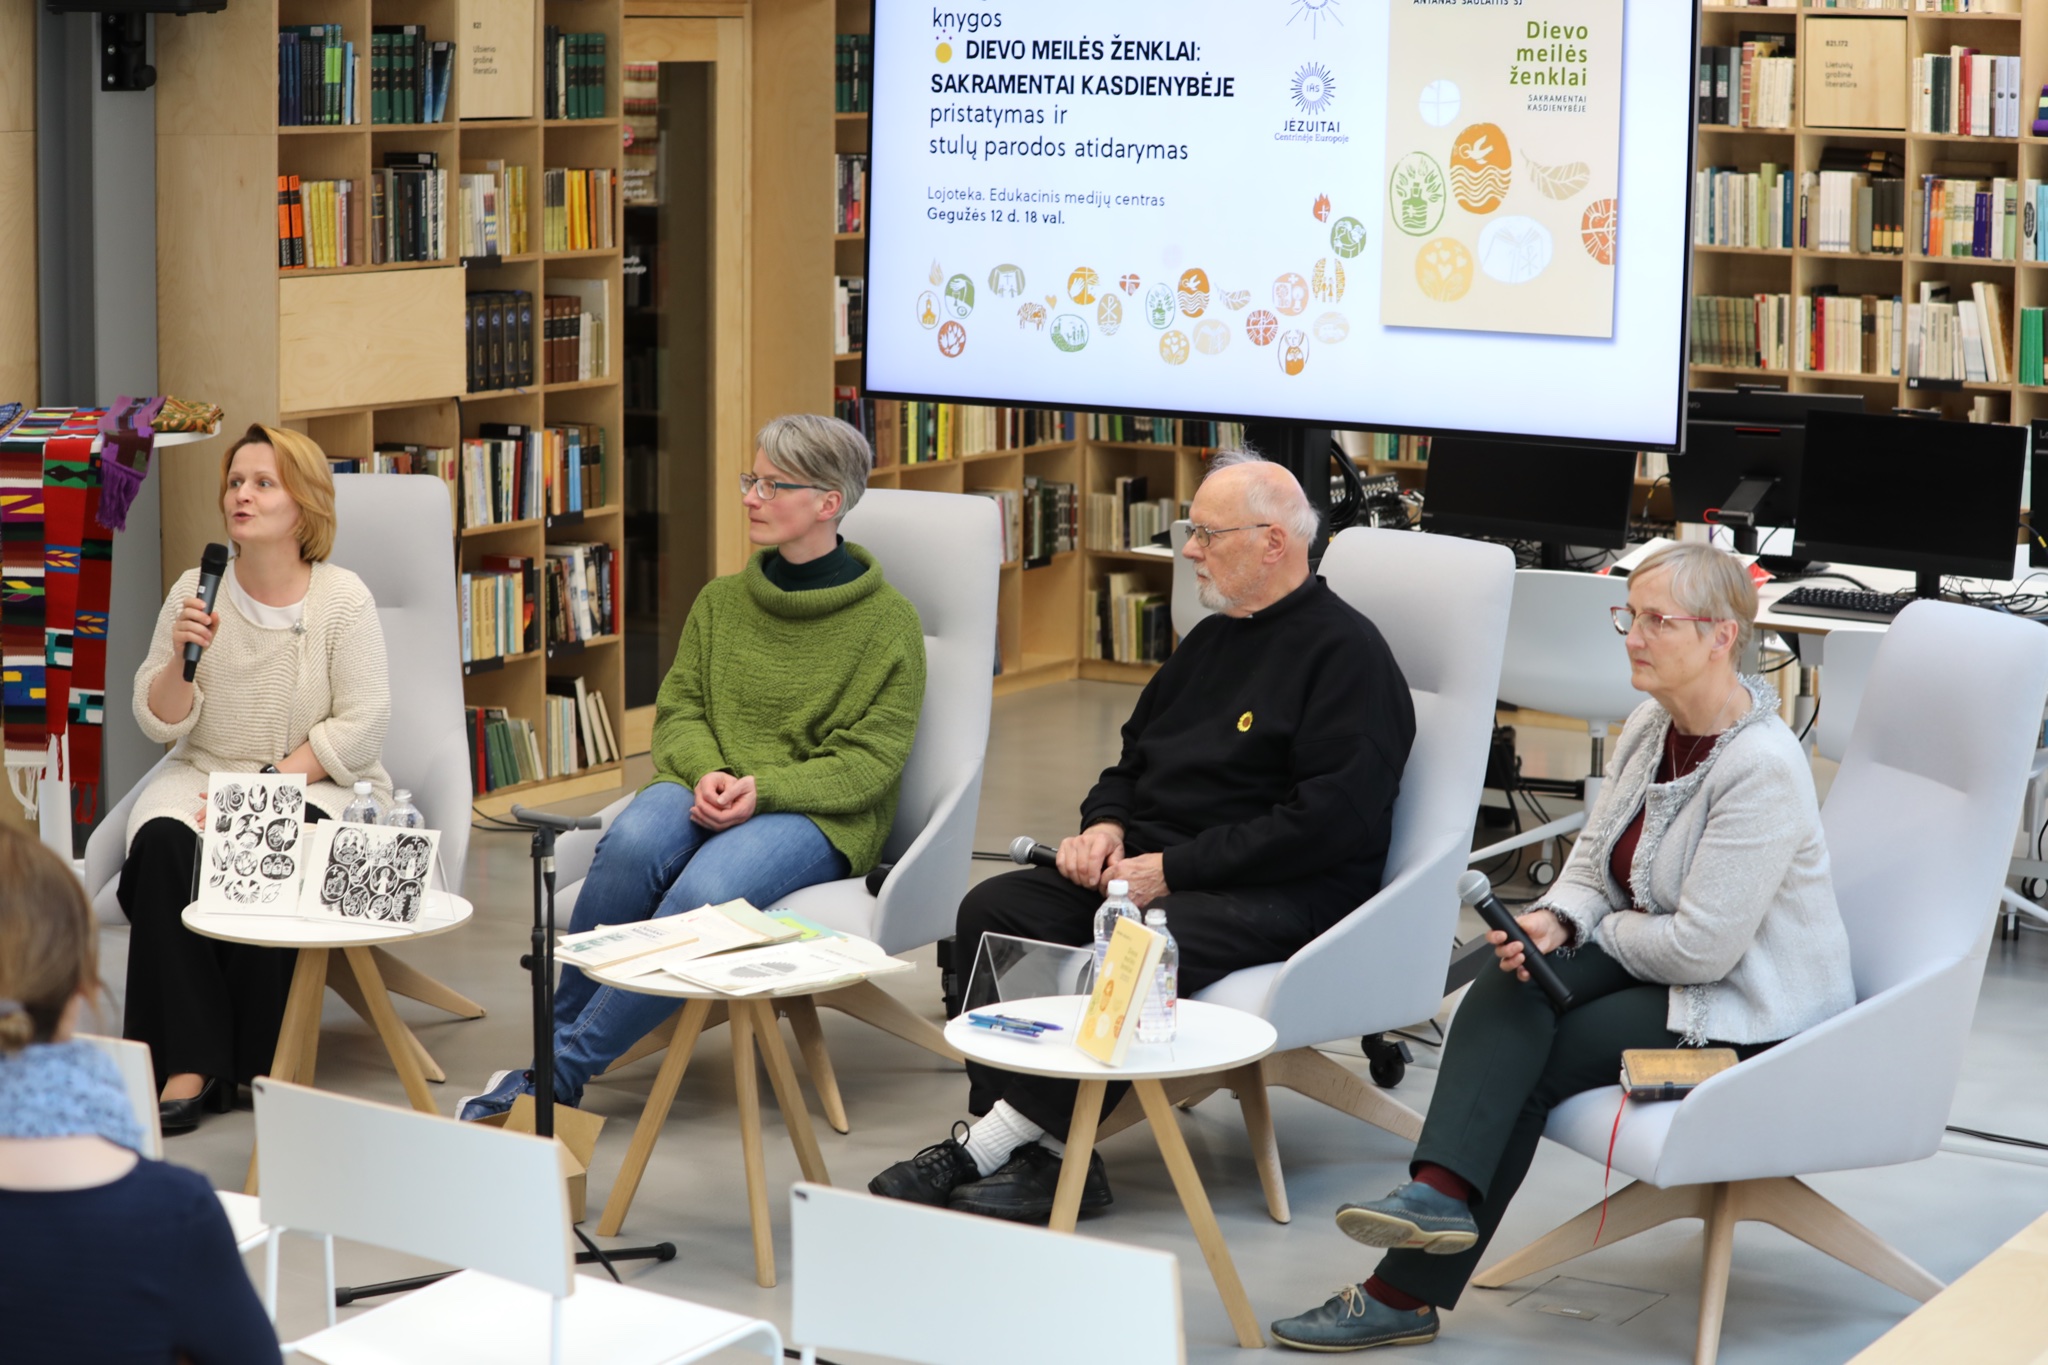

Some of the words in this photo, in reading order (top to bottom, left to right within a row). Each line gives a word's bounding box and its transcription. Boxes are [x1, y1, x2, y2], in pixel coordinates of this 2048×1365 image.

[932, 7, 1003, 33] knygos
[1526, 20, 1589, 41] Dievo
[965, 38, 1026, 60] DIEVO
[1032, 35, 1104, 61] MEILĖS
[1110, 34, 1201, 62] ŽENKLAI:
[1516, 44, 1589, 64] meilės
[931, 73, 1075, 96] SAKRAMENTAI
[1081, 72, 1235, 98] KASDIENYBĖJE
[1509, 66, 1588, 87] ženklai
[1825, 80, 1858, 88] literatūra
[1527, 94, 1587, 103] SAKRAMENTAI
[1527, 103, 1587, 113] KASDIENYBĖJE
[930, 103, 1045, 128] pristatymas
[1053, 104, 1068, 124] ir
[1284, 118, 1340, 133] JĖZUITAI
[1274, 133, 1313, 143] Centrinėje
[1315, 134, 1349, 144] Europoje
[929, 134, 978, 160] stulų
[984, 136, 1066, 161] parodos
[1074, 137, 1189, 164] atidarymas
[927, 186, 986, 206] Lojoteka.
[990, 188, 1060, 204] Edukacinis
[1064, 191, 1112, 208] medijų
[1115, 193, 1166, 207] centras
[927, 206, 987, 224] Gegužės
[990, 209, 1003, 223] 12
[1007, 209, 1020, 223] d.
[1025, 210, 1038, 224] 18
[1042, 210, 1065, 225] val.
[1909, 379, 1919, 388] M
[465, 665, 471, 675] U
